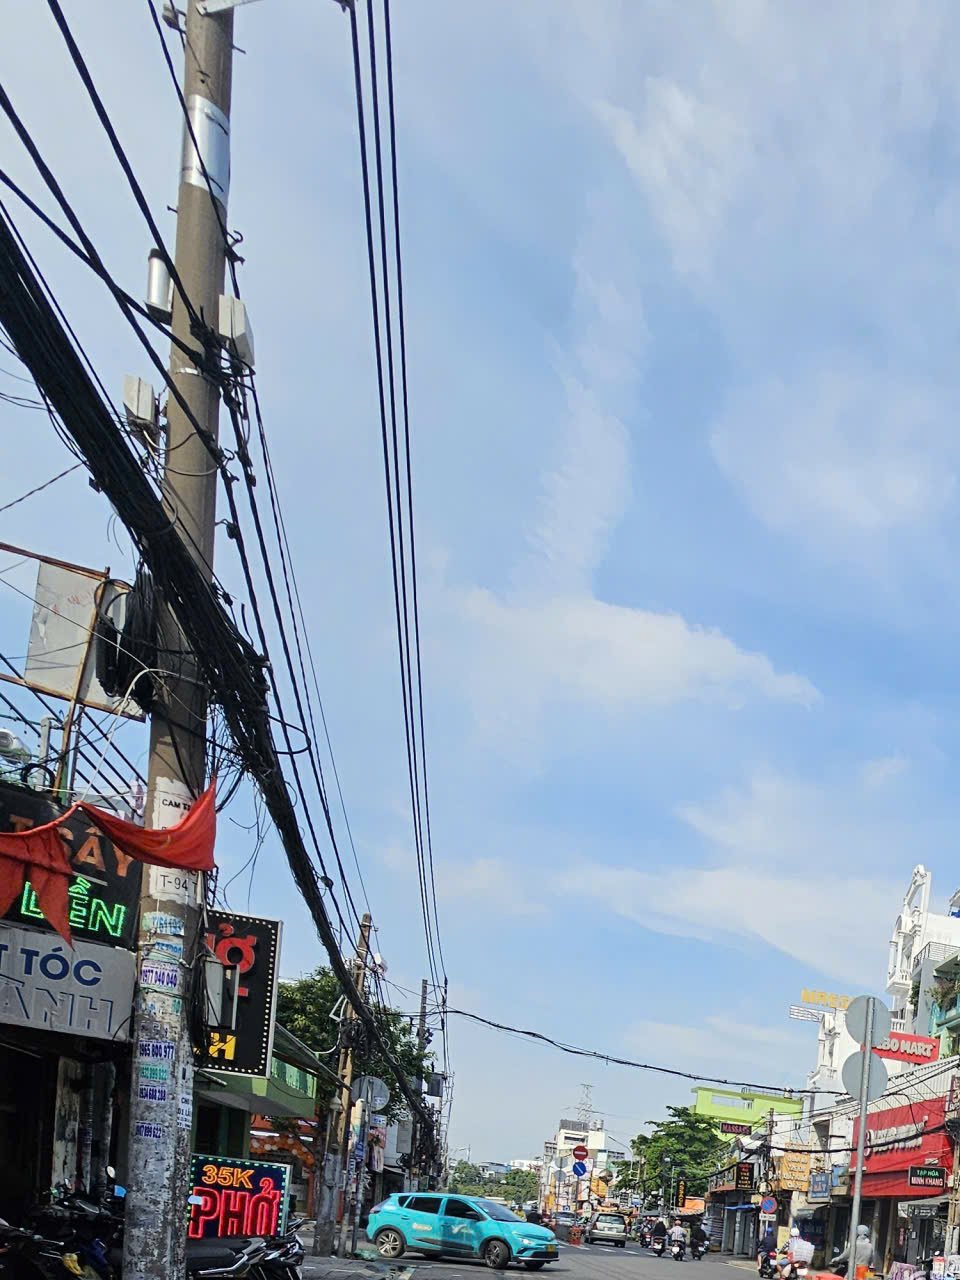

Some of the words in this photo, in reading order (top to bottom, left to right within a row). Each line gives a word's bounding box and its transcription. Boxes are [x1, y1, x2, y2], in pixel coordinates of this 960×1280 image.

[160, 874, 188, 892] T-94
[20, 946, 102, 986] TÓC
[901, 1040, 934, 1058] MART
[201, 1164, 254, 1189] 35K
[925, 1178, 943, 1186] KHANG
[188, 1177, 280, 1238] PHỞ
